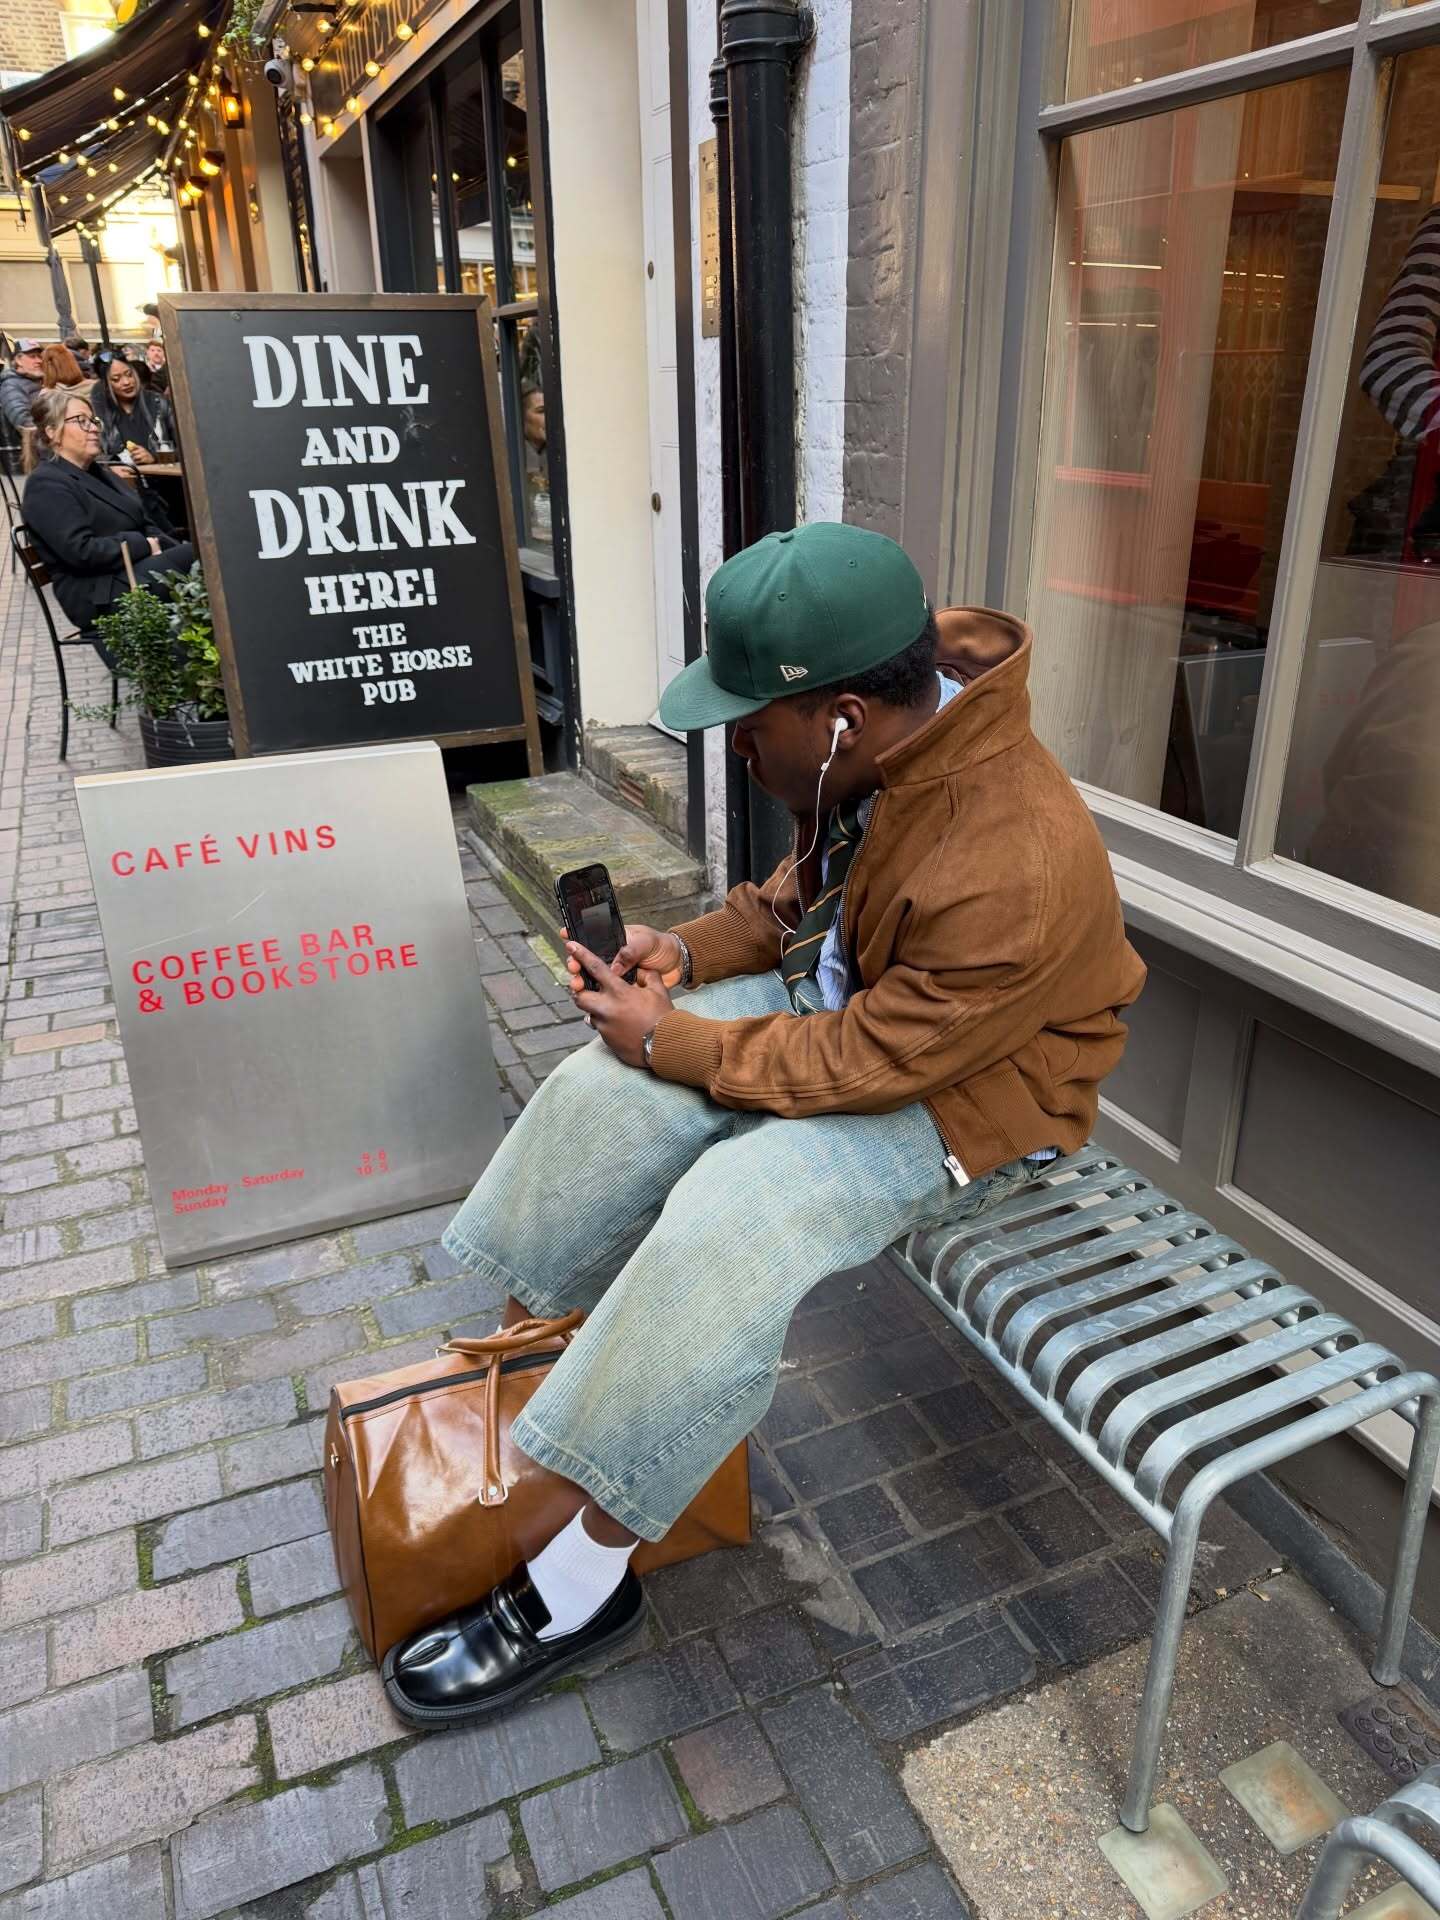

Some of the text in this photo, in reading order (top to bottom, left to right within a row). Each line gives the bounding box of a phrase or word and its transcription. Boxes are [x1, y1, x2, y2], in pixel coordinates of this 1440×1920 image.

[242, 335, 429, 408] DINE
[301, 426, 400, 466] AND
[249, 480, 476, 559] DRINK
[304, 568, 438, 615] HERE!
[352, 623, 407, 649] THE
[287, 645, 473, 684] WHITE HORSE
[360, 679, 416, 706] PUB
[111, 824, 336, 878] CAFÉ VINS
[132, 923, 375, 986] COFFEE BAR
[138, 943, 419, 1014] & BOOKSTORE
[171, 1168, 305, 1202] Monday Saturday
[173, 1196, 228, 1215] Sunday
